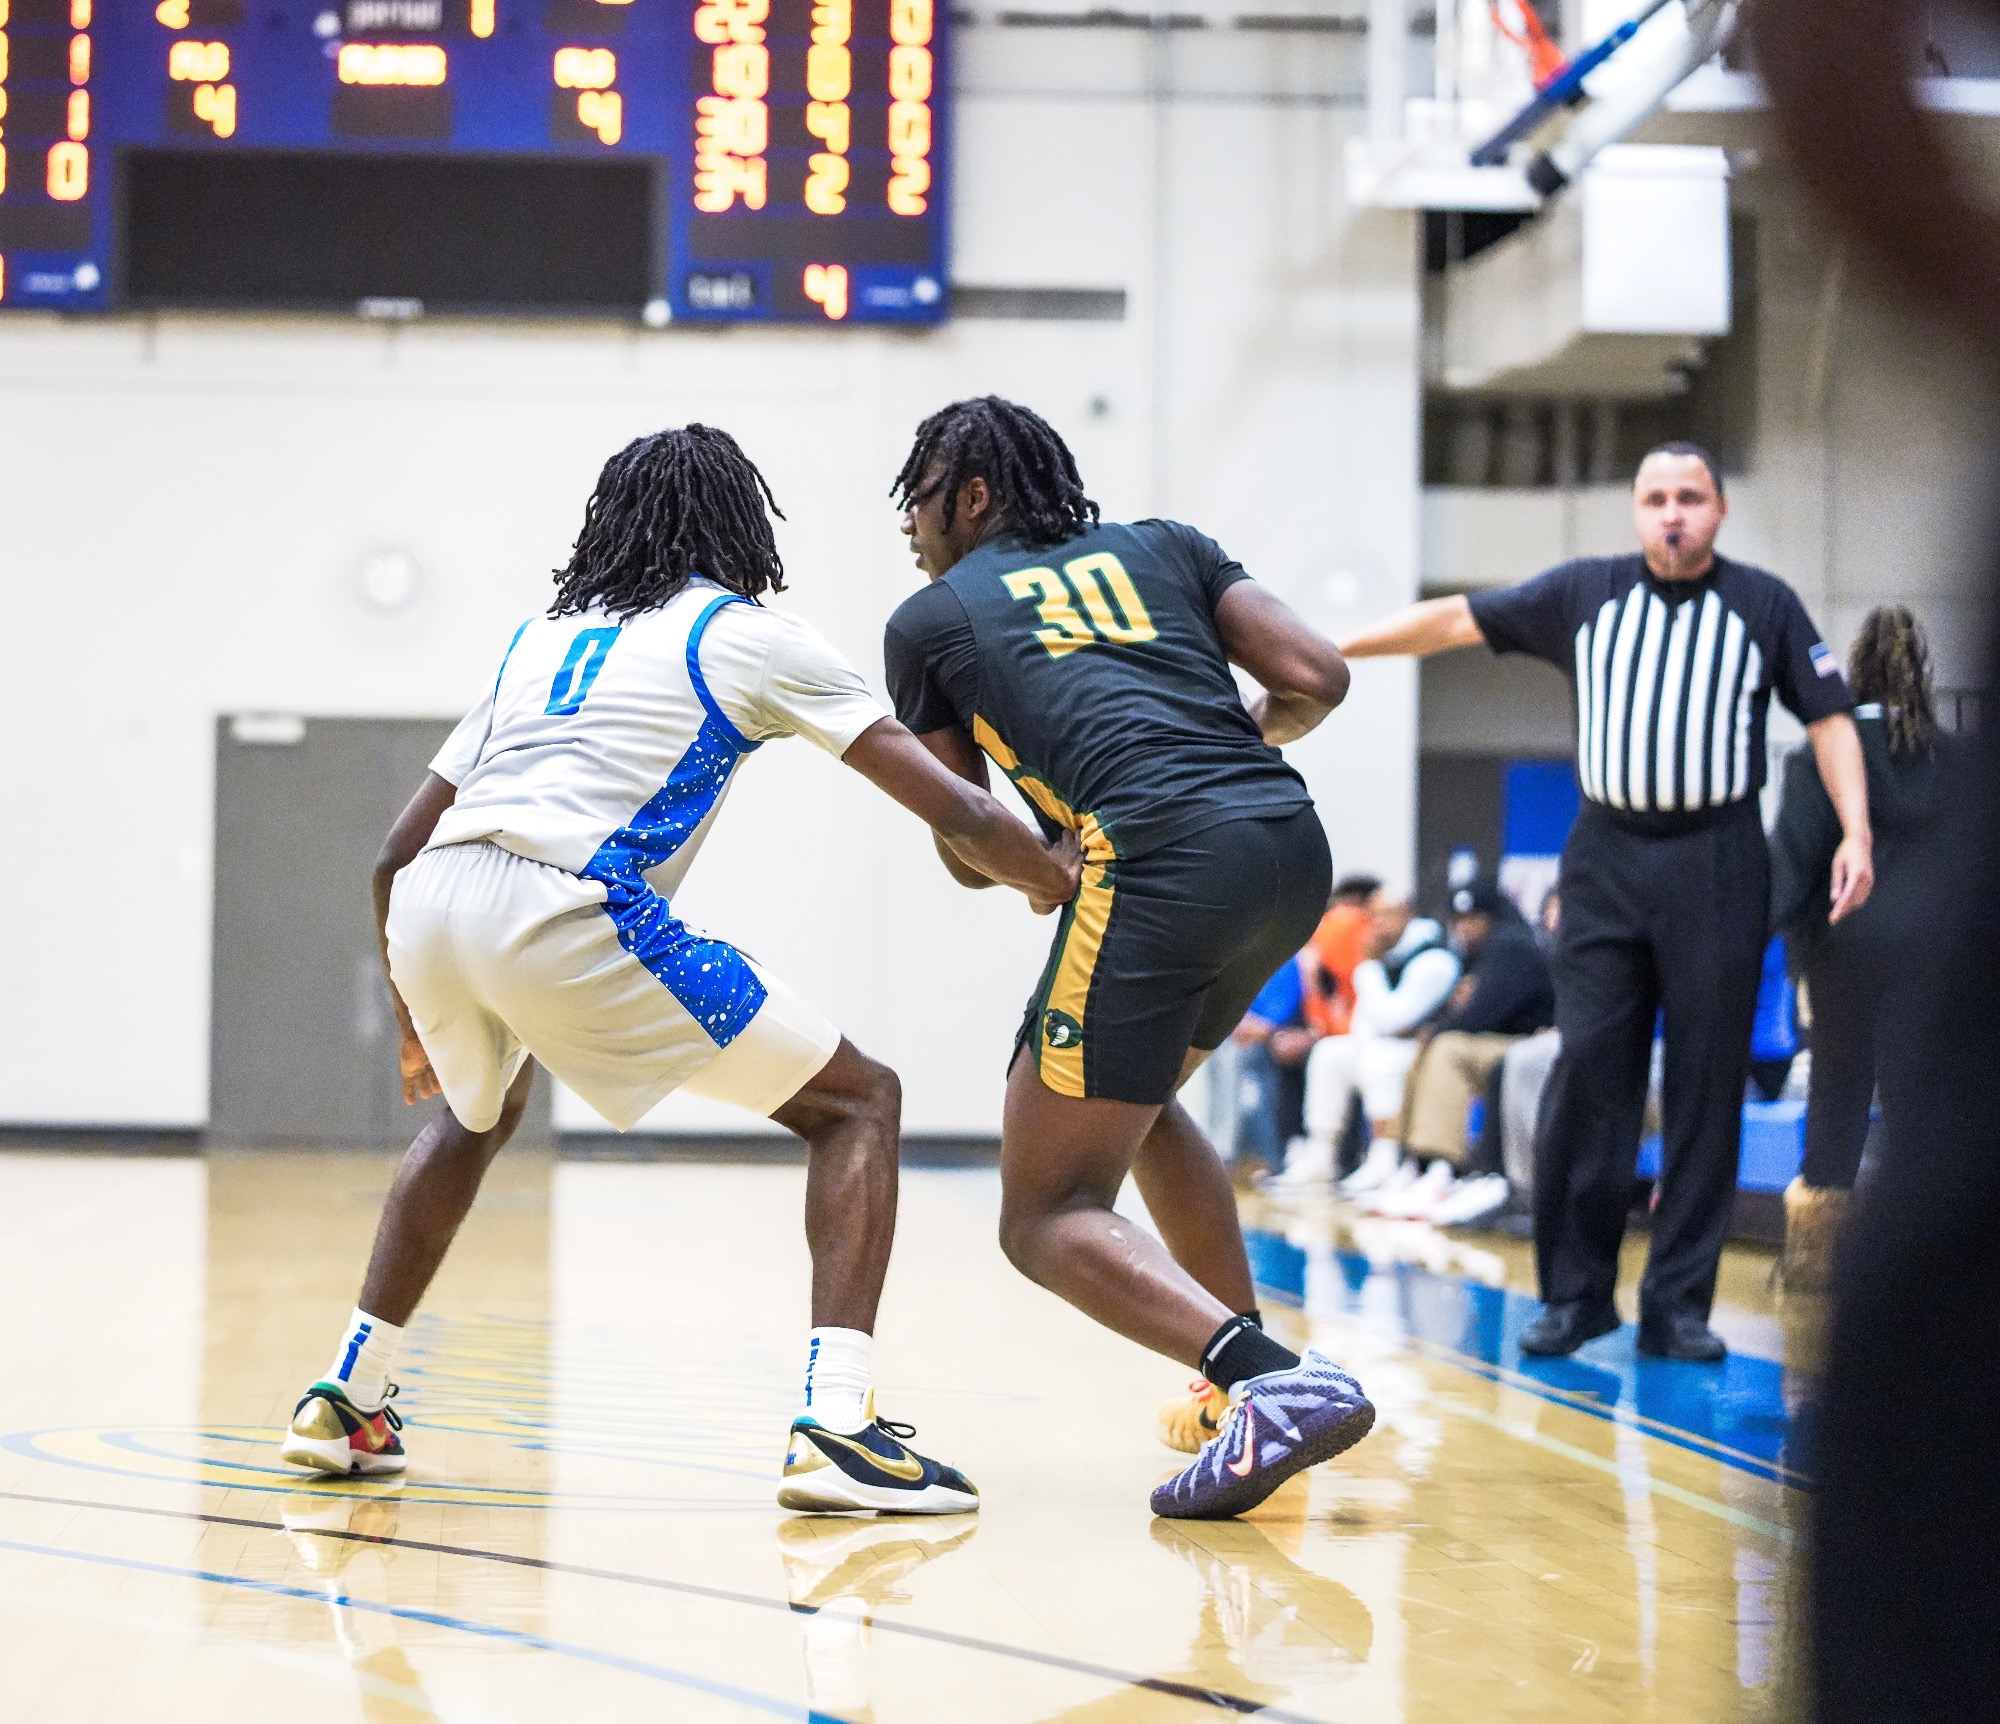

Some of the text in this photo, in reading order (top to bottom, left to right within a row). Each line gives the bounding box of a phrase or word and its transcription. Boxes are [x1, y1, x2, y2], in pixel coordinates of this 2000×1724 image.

[194, 84, 236, 138] 4
[577, 91, 622, 145] 4
[806, 102, 850, 154] 4
[47, 141, 88, 201] 0
[804, 153, 849, 215] 2
[887, 157, 930, 216] 2
[803, 264, 848, 320] 4
[999, 551, 1161, 661] 30
[543, 626, 622, 716] 0
